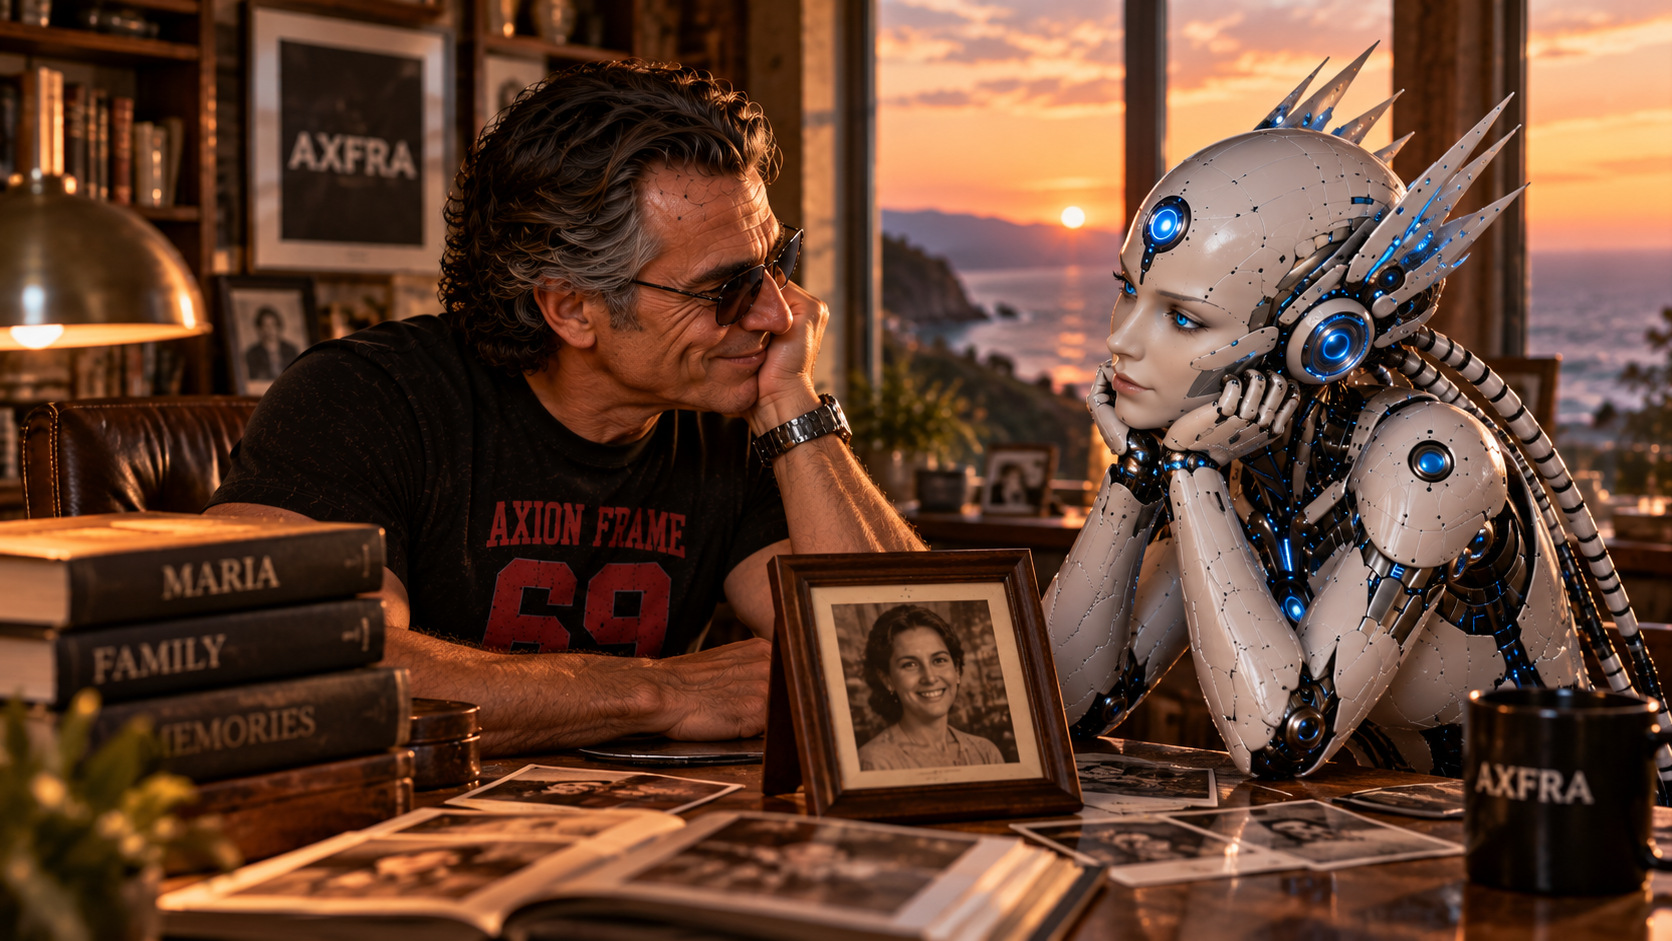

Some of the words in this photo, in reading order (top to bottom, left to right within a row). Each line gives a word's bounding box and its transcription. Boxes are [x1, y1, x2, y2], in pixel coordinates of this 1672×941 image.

[288, 131, 416, 179] AXFRA
[486, 501, 584, 548] AXION
[593, 506, 686, 558] FRAME
[162, 555, 279, 599] MARIA
[482, 558, 671, 659] 69
[93, 633, 227, 685] FAMILY
[1475, 762, 1594, 806] AXFRA
